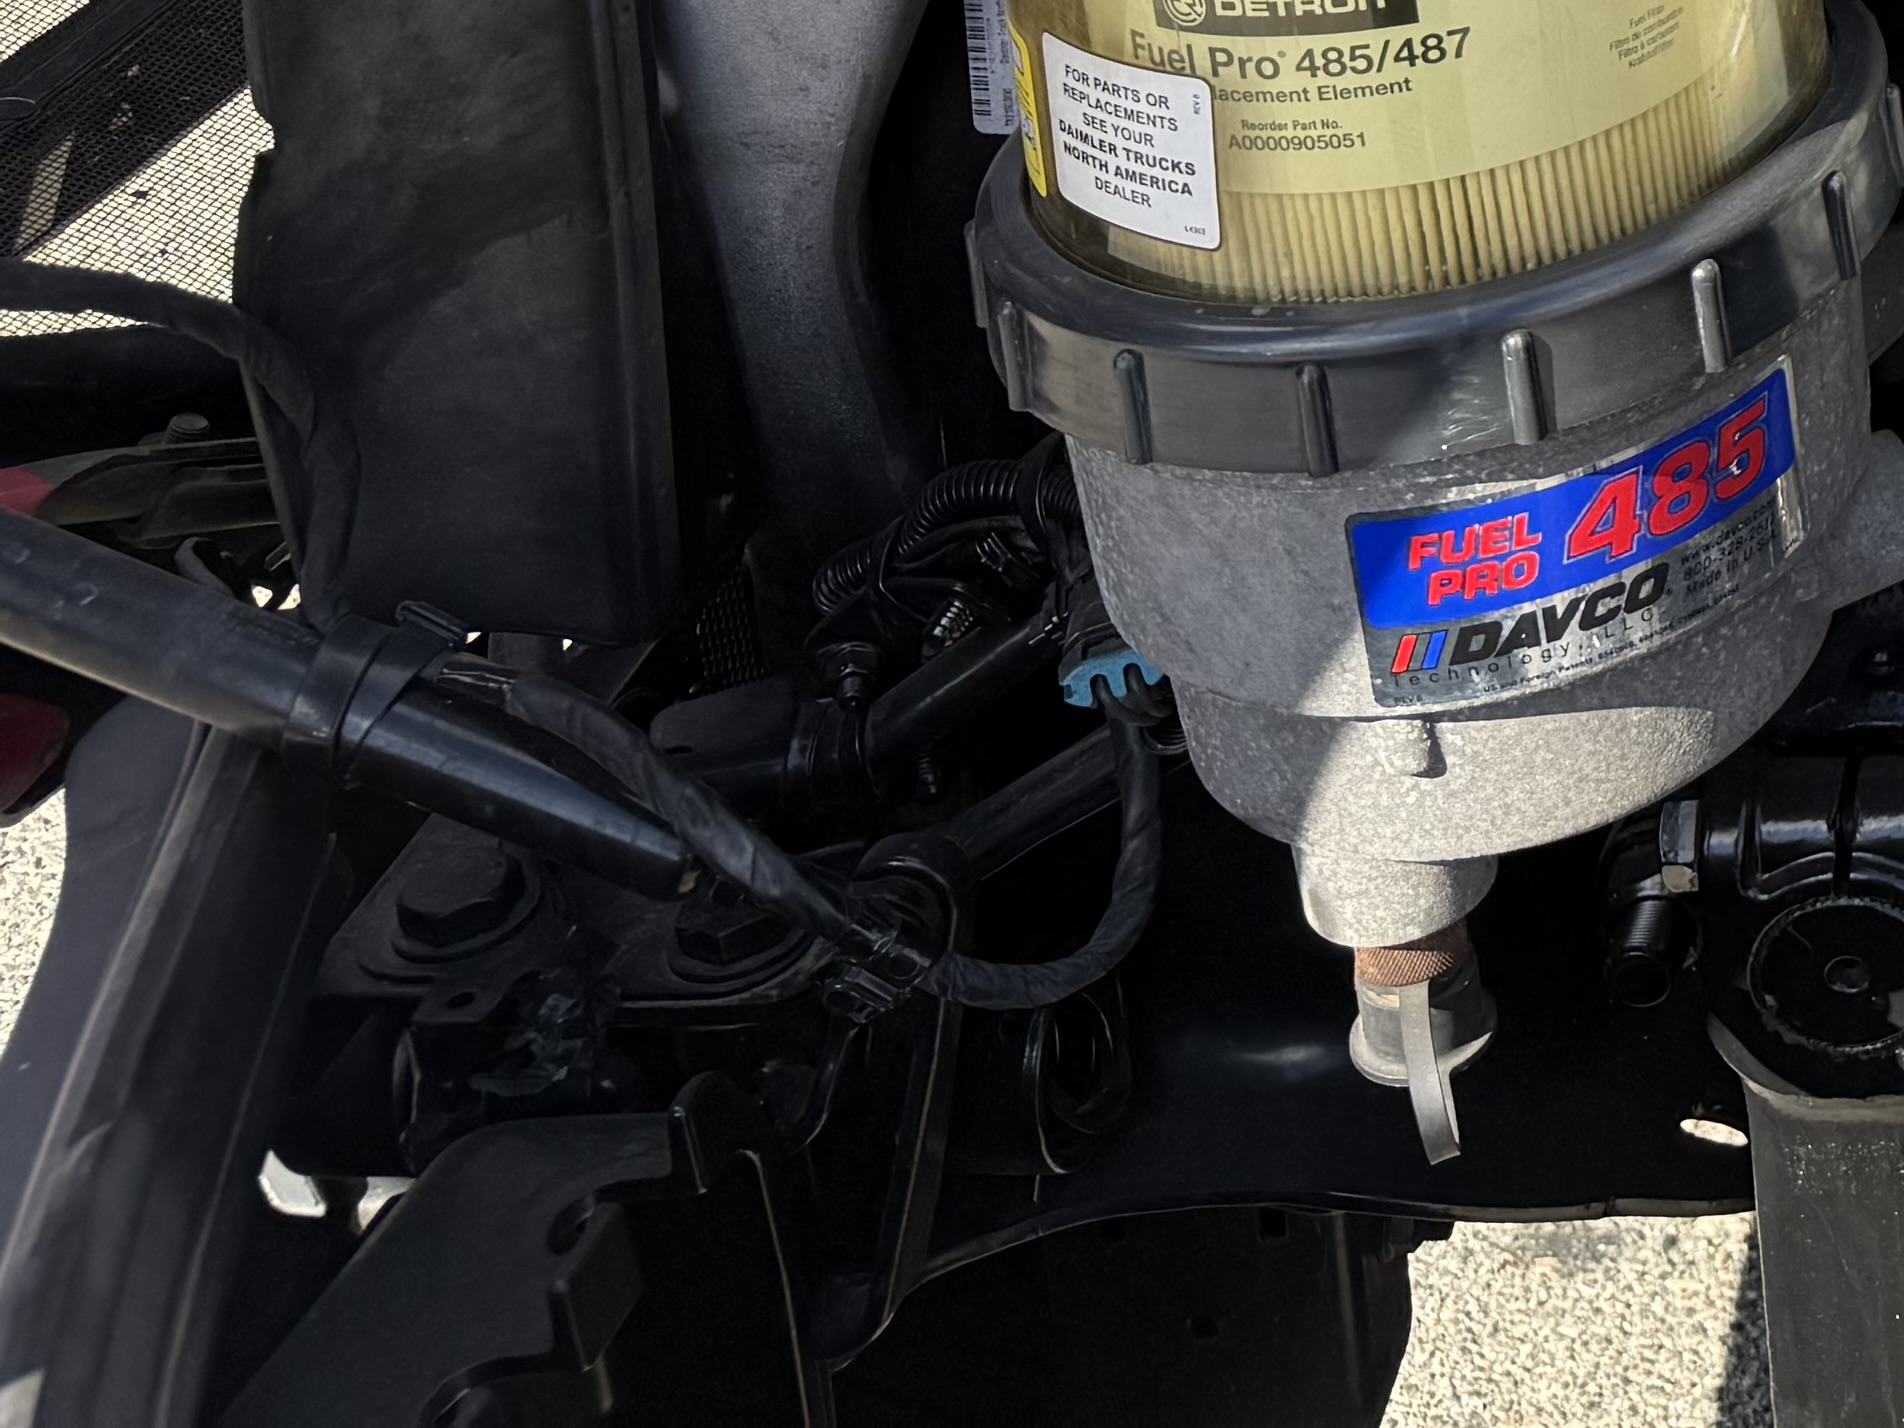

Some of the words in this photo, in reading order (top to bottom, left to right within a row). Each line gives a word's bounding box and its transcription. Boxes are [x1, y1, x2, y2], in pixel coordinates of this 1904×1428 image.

[1130, 28, 1197, 75] Fuel
[1295, 26, 1471, 78] 485/487
[1063, 83, 1178, 132] REPLACEMENTS
[1065, 64, 1090, 87] FOR
[1094, 77, 1141, 104] PARTS
[1145, 93, 1170, 110] OR
[1317, 76, 1413, 101] Element
[1059, 119, 1118, 158] DAIMLER
[1122, 147, 1196, 176] TRUCKS
[1082, 112, 1108, 134] SEE
[1111, 122, 1155, 148] YOUR
[1228, 131, 1367, 151] A0000905051
[1241, 119, 1289, 132] Reorder
[1291, 118, 1317, 130] Part
[1320, 117, 1343, 130] No.
[1063, 140, 1109, 174] NORTH
[1114, 165, 1193, 196] AMERICA
[1094, 176, 1152, 208] DEALER
[1563, 392, 1769, 564] 485
[1408, 512, 1542, 572] FUEL
[1427, 551, 1540, 606] PRO
[1686, 569, 1722, 594] Made
[1727, 559, 1739, 572] in
[1448, 561, 1670, 666] DAVCO
